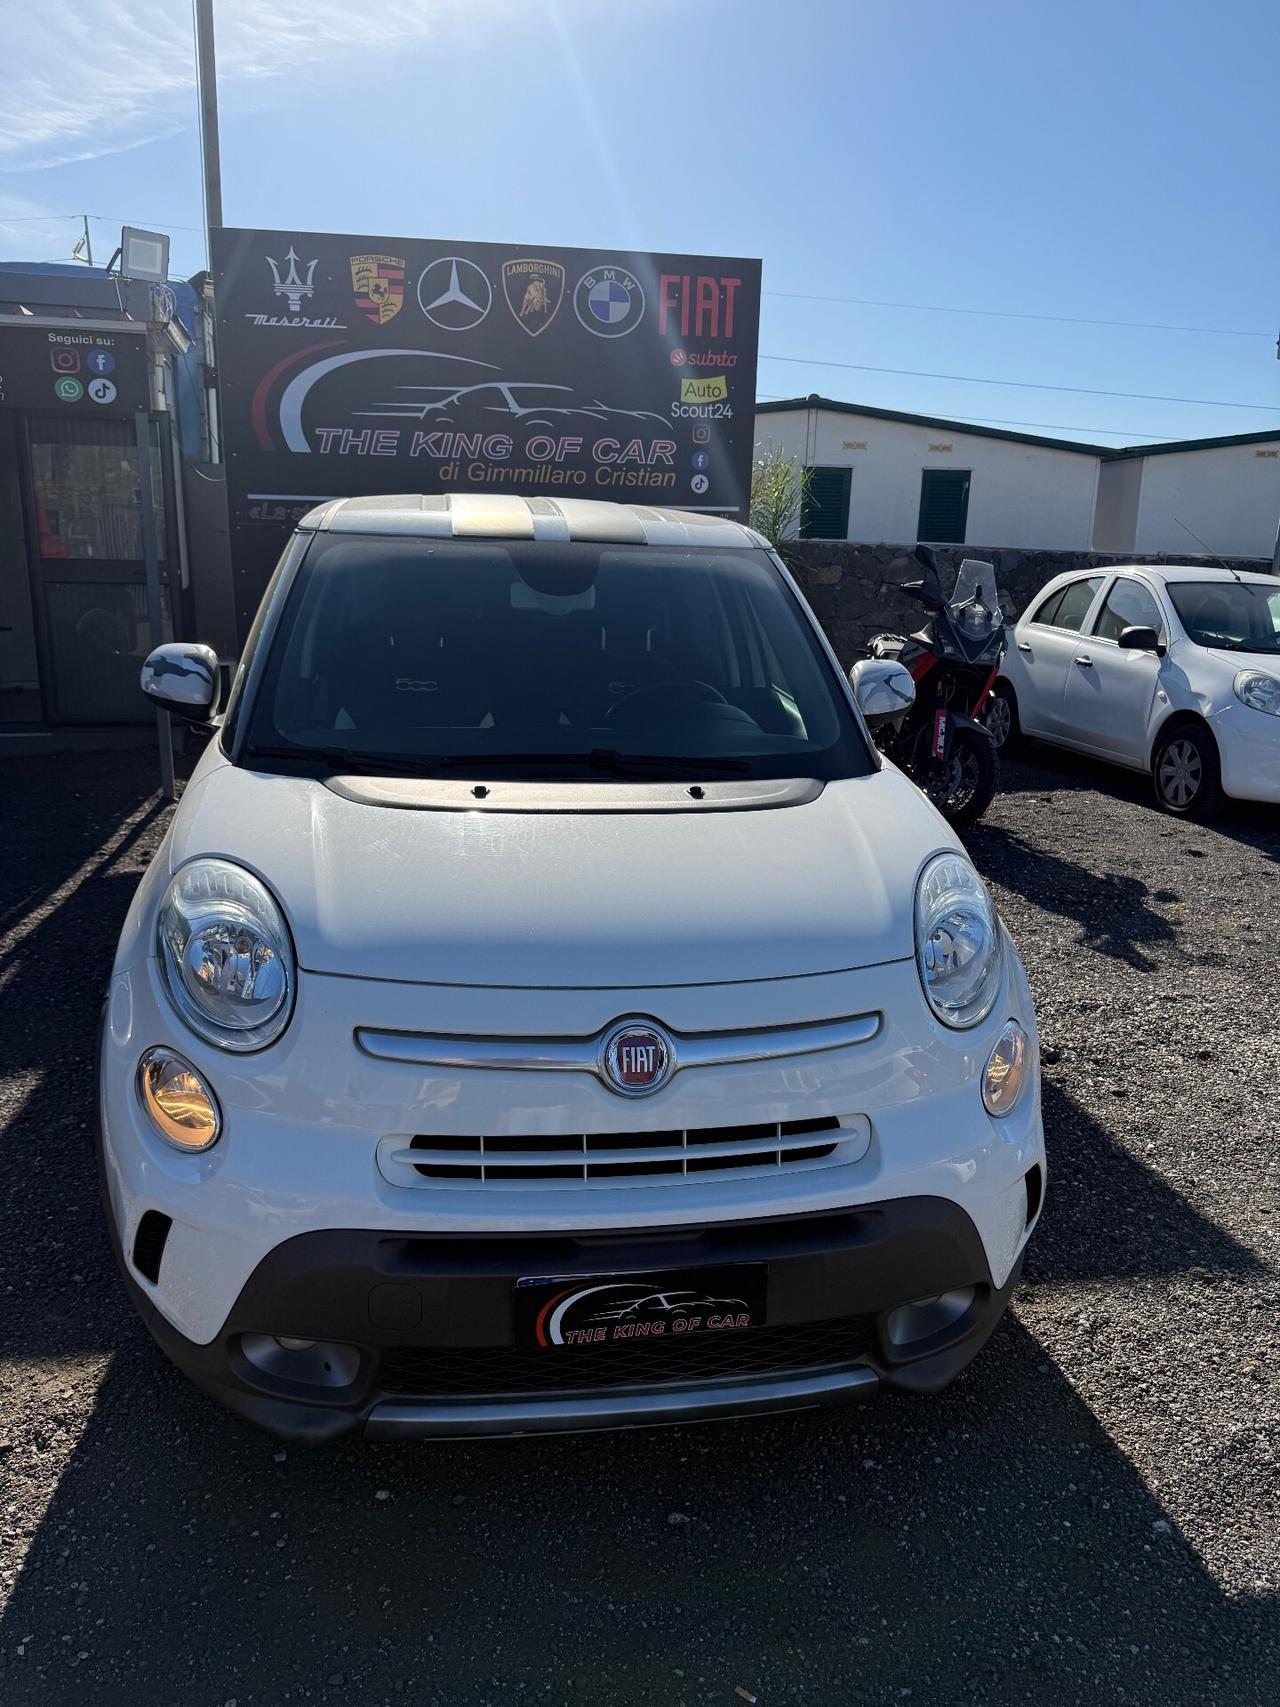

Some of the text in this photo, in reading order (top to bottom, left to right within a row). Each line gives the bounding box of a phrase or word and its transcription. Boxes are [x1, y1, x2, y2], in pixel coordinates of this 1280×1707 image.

[350, 255, 405, 267] PORSCHE
[506, 262, 561, 279] LAMBORGHINI
[583, 270, 635, 290] BMW
[658, 274, 742, 338] FIAT
[48, 332, 115, 347] Seguici su:
[684, 382, 722, 398] Auto
[671, 401, 734, 419] Scout24
[315, 428, 677, 465] THE KING OF CAR
[439, 462, 460, 481] di
[595, 466, 677, 487] Cristian
[622, 1046, 656, 1073] FIAT
[566, 1312, 750, 1345] THE KING OF CAR
